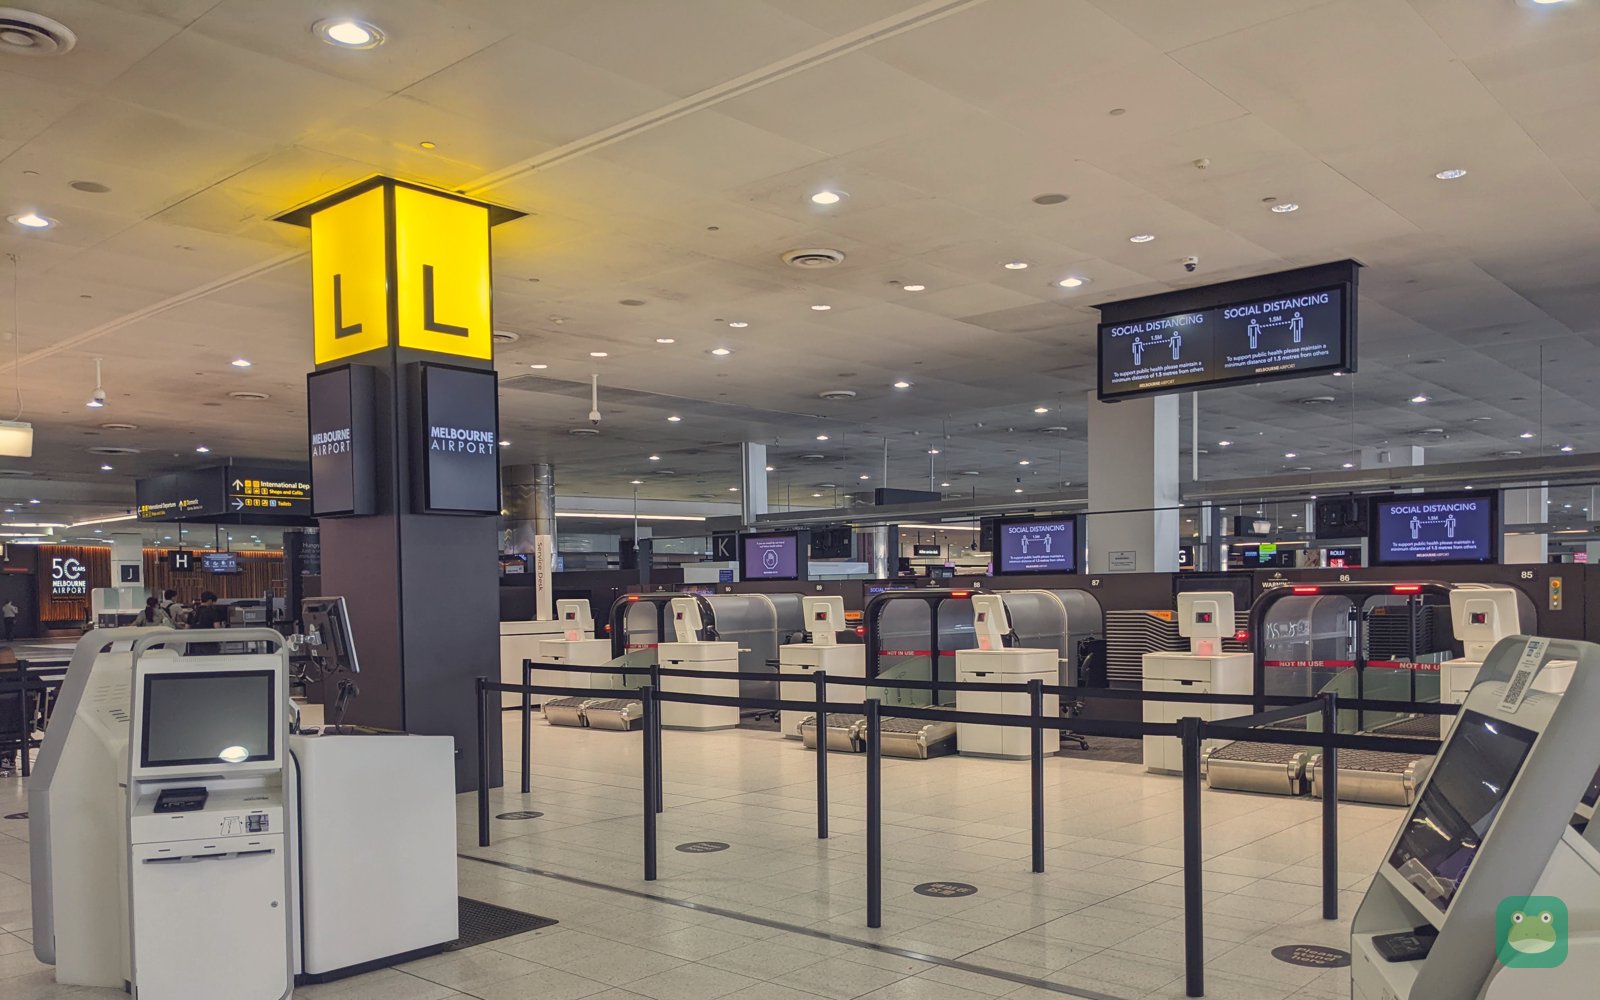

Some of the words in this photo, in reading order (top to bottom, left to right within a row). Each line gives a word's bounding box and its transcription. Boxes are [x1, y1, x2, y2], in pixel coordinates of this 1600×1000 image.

[334, 274, 362, 339] L
[423, 264, 468, 337] L
[1224, 305, 1261, 319] SOCIAL
[1264, 293, 1328, 312] DISTANCING
[1112, 324, 1144, 337] SOCIAL
[1146, 314, 1203, 332] DISTANCING
[312, 428, 350, 445] MELBOURNE
[431, 426, 493, 442] MELBOURNE
[313, 441, 350, 456] AIRPORT
[431, 441, 493, 454] AIRPORT
[261, 480, 297, 489] International
[1391, 506, 1421, 514] SOCIAL
[1423, 503, 1476, 513] DISTANCING
[719, 538, 729, 556] K
[176, 554, 187, 568] H
[1282, 554, 1288, 564] F
[128, 568, 132, 579] J
[1292, 955, 1325, 964] here
[1293, 952, 1336, 961] stand
[1296, 948, 1342, 958] Please
